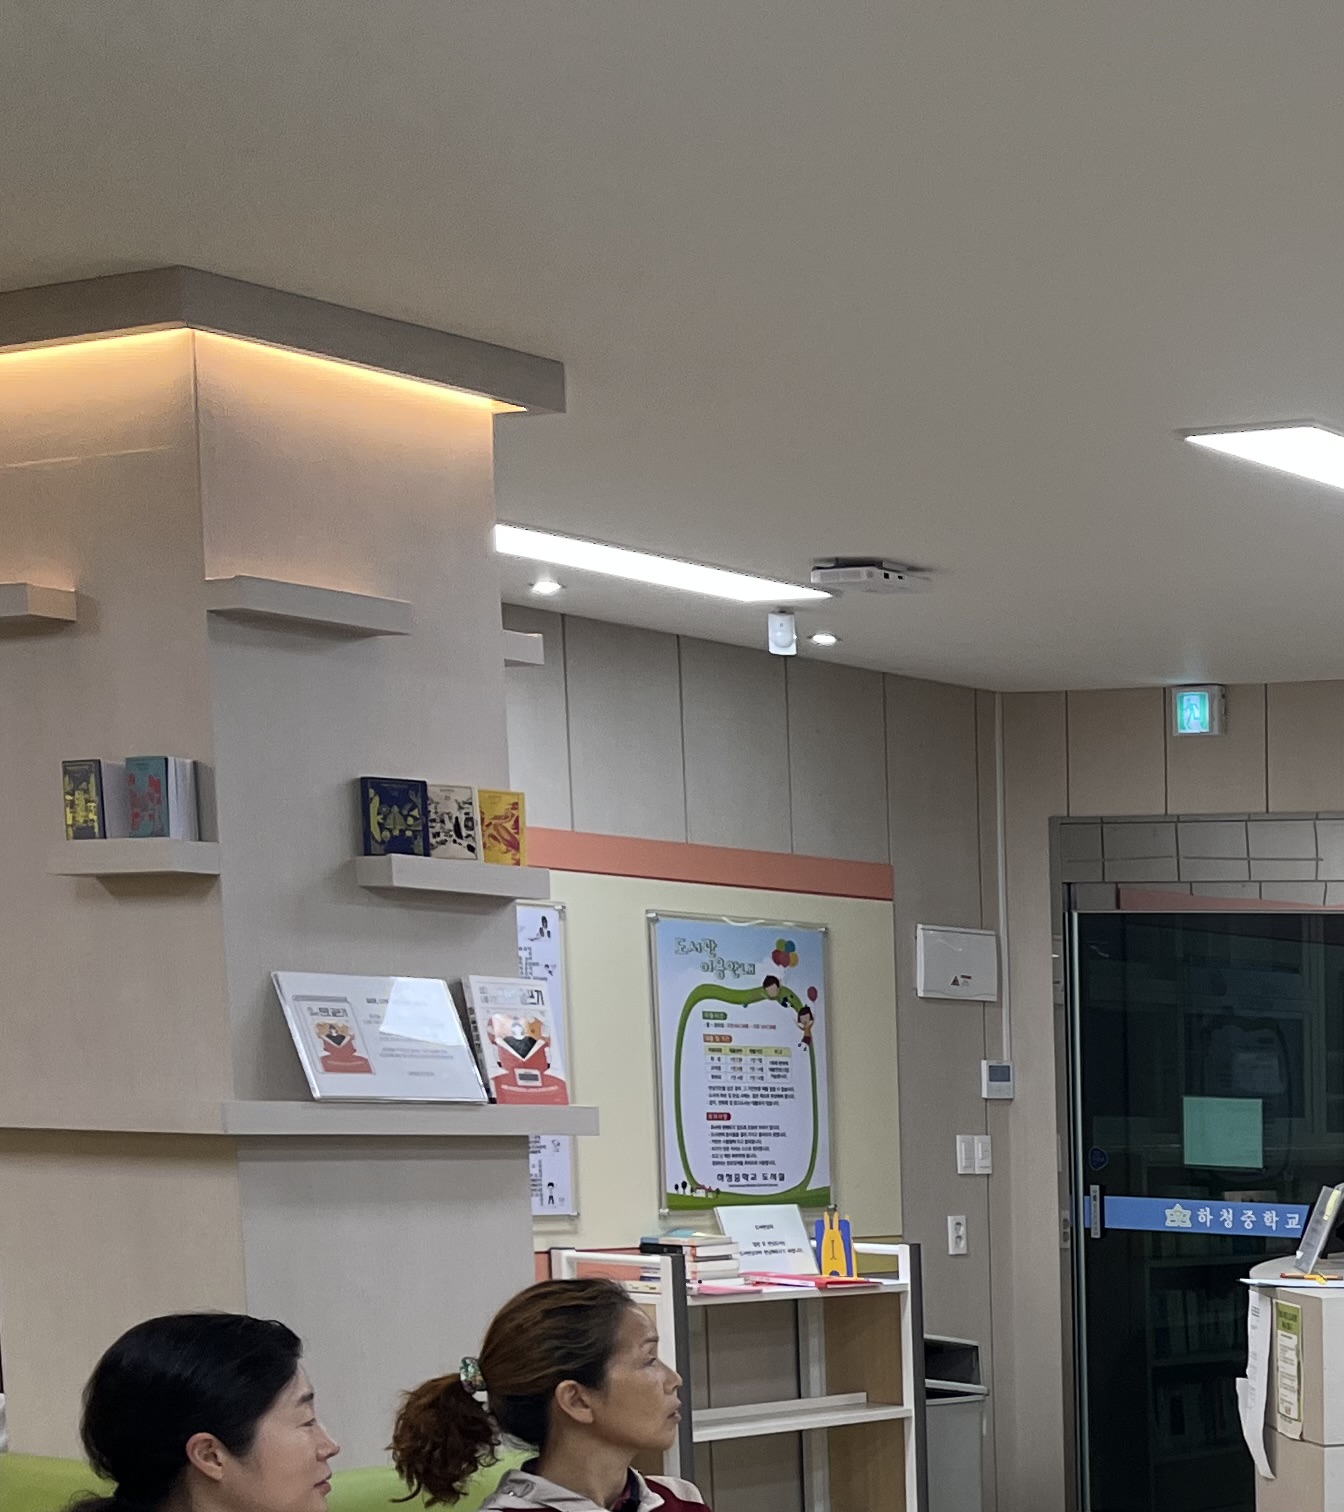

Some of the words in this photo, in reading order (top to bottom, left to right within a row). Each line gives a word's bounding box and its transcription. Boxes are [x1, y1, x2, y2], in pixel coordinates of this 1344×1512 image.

[674, 937, 718, 957] 도서관
[699, 957, 756, 980] 이용안내
[716, 1173, 758, 1183] 하청중학교
[1197, 1206, 1301, 1231] 하청중학교
